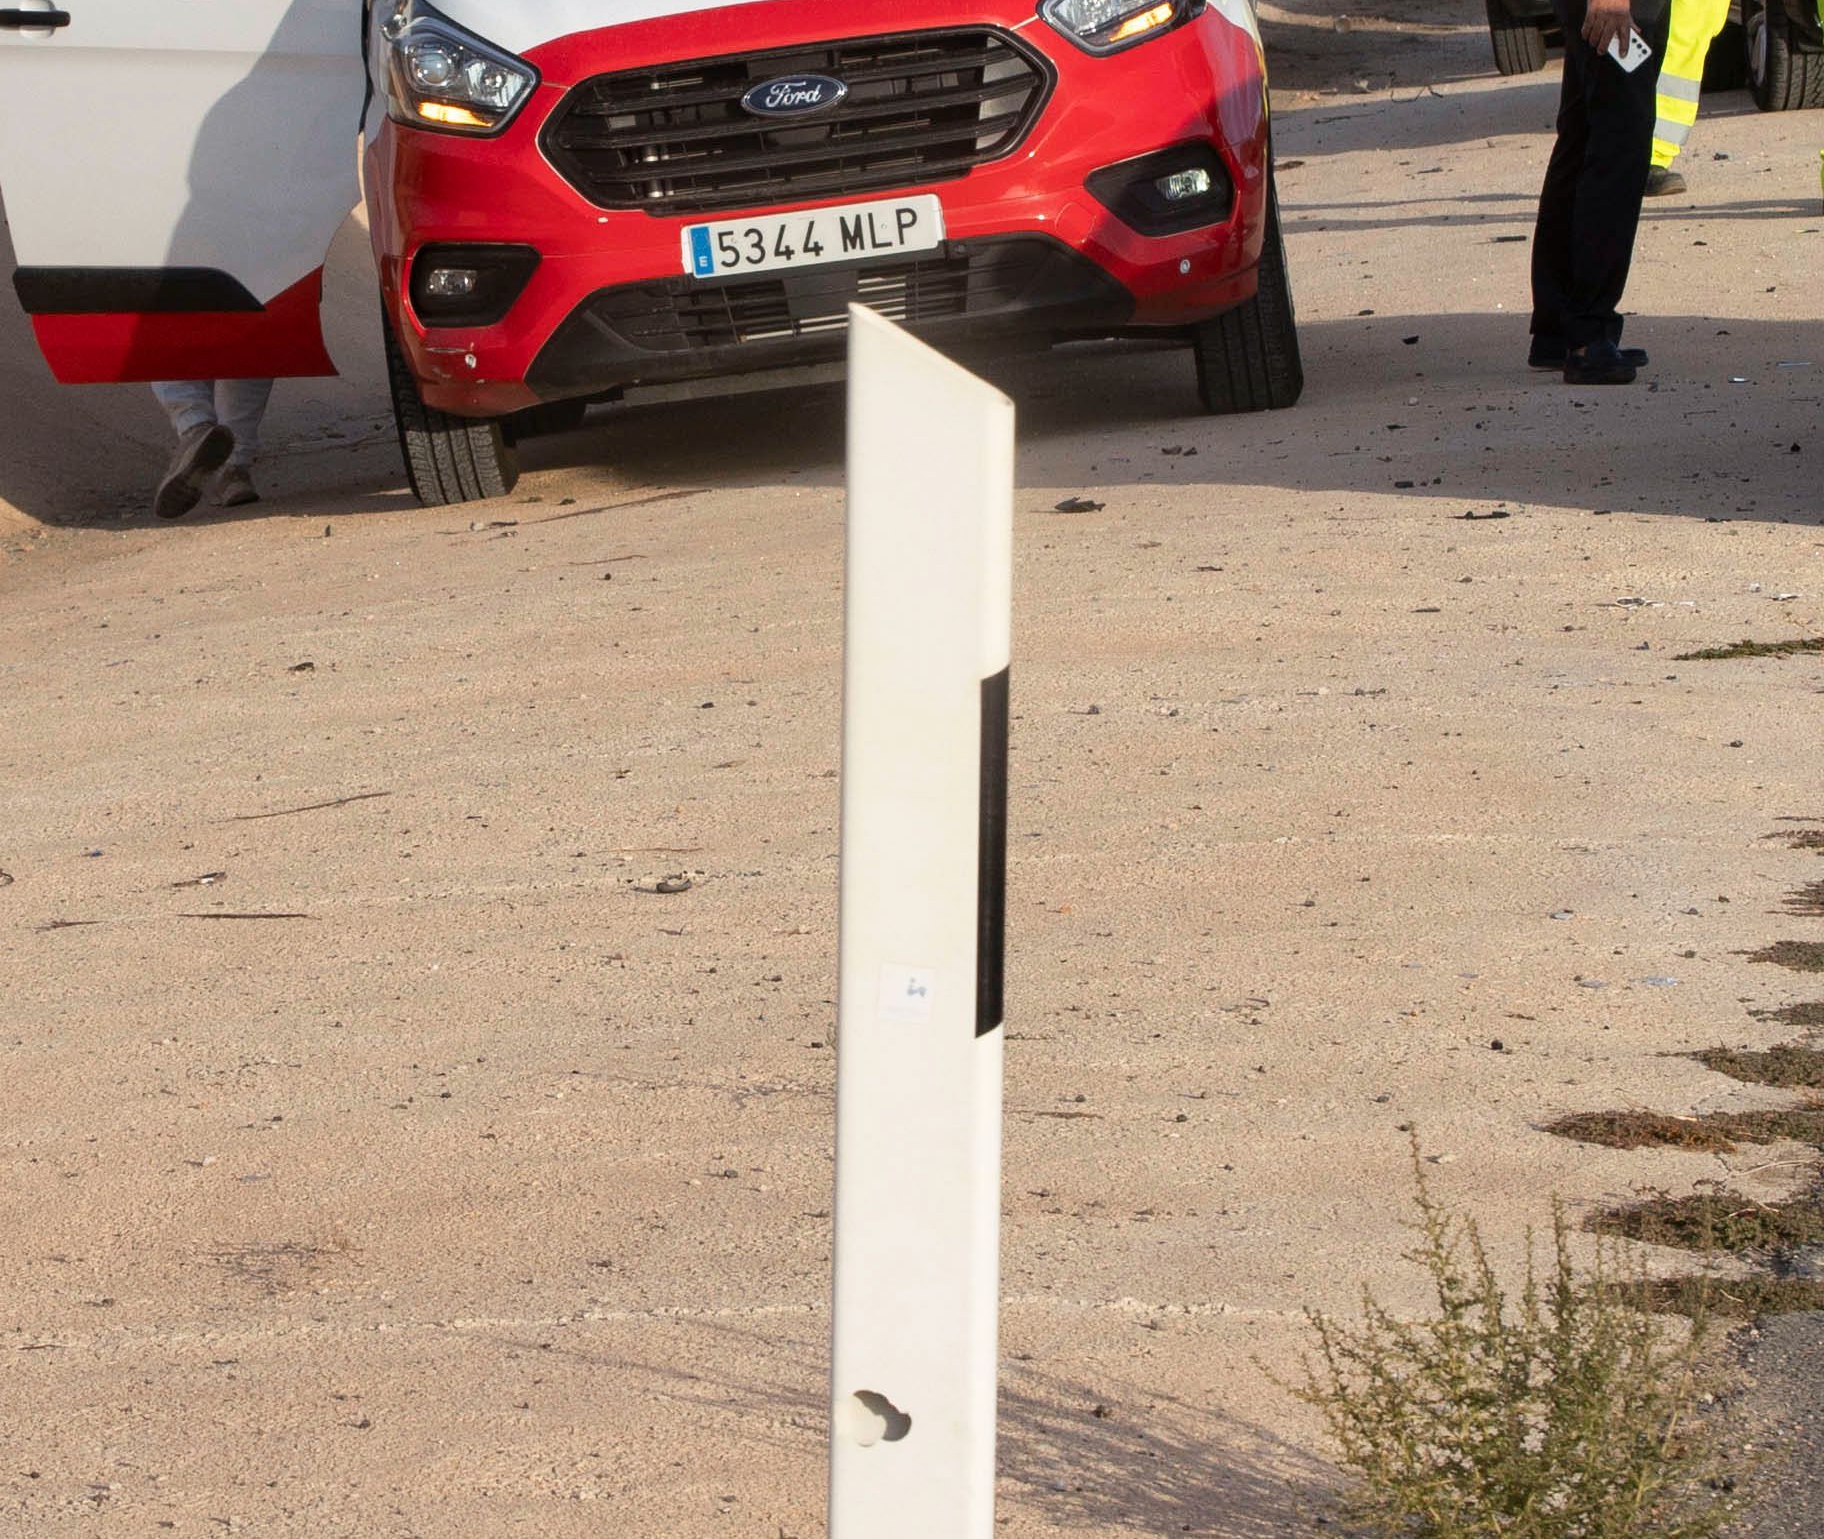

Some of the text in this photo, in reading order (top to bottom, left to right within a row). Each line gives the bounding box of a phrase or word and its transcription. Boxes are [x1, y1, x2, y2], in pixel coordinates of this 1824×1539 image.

[765, 80, 822, 108] Ford
[699, 207, 918, 268] E 5344 MLP
